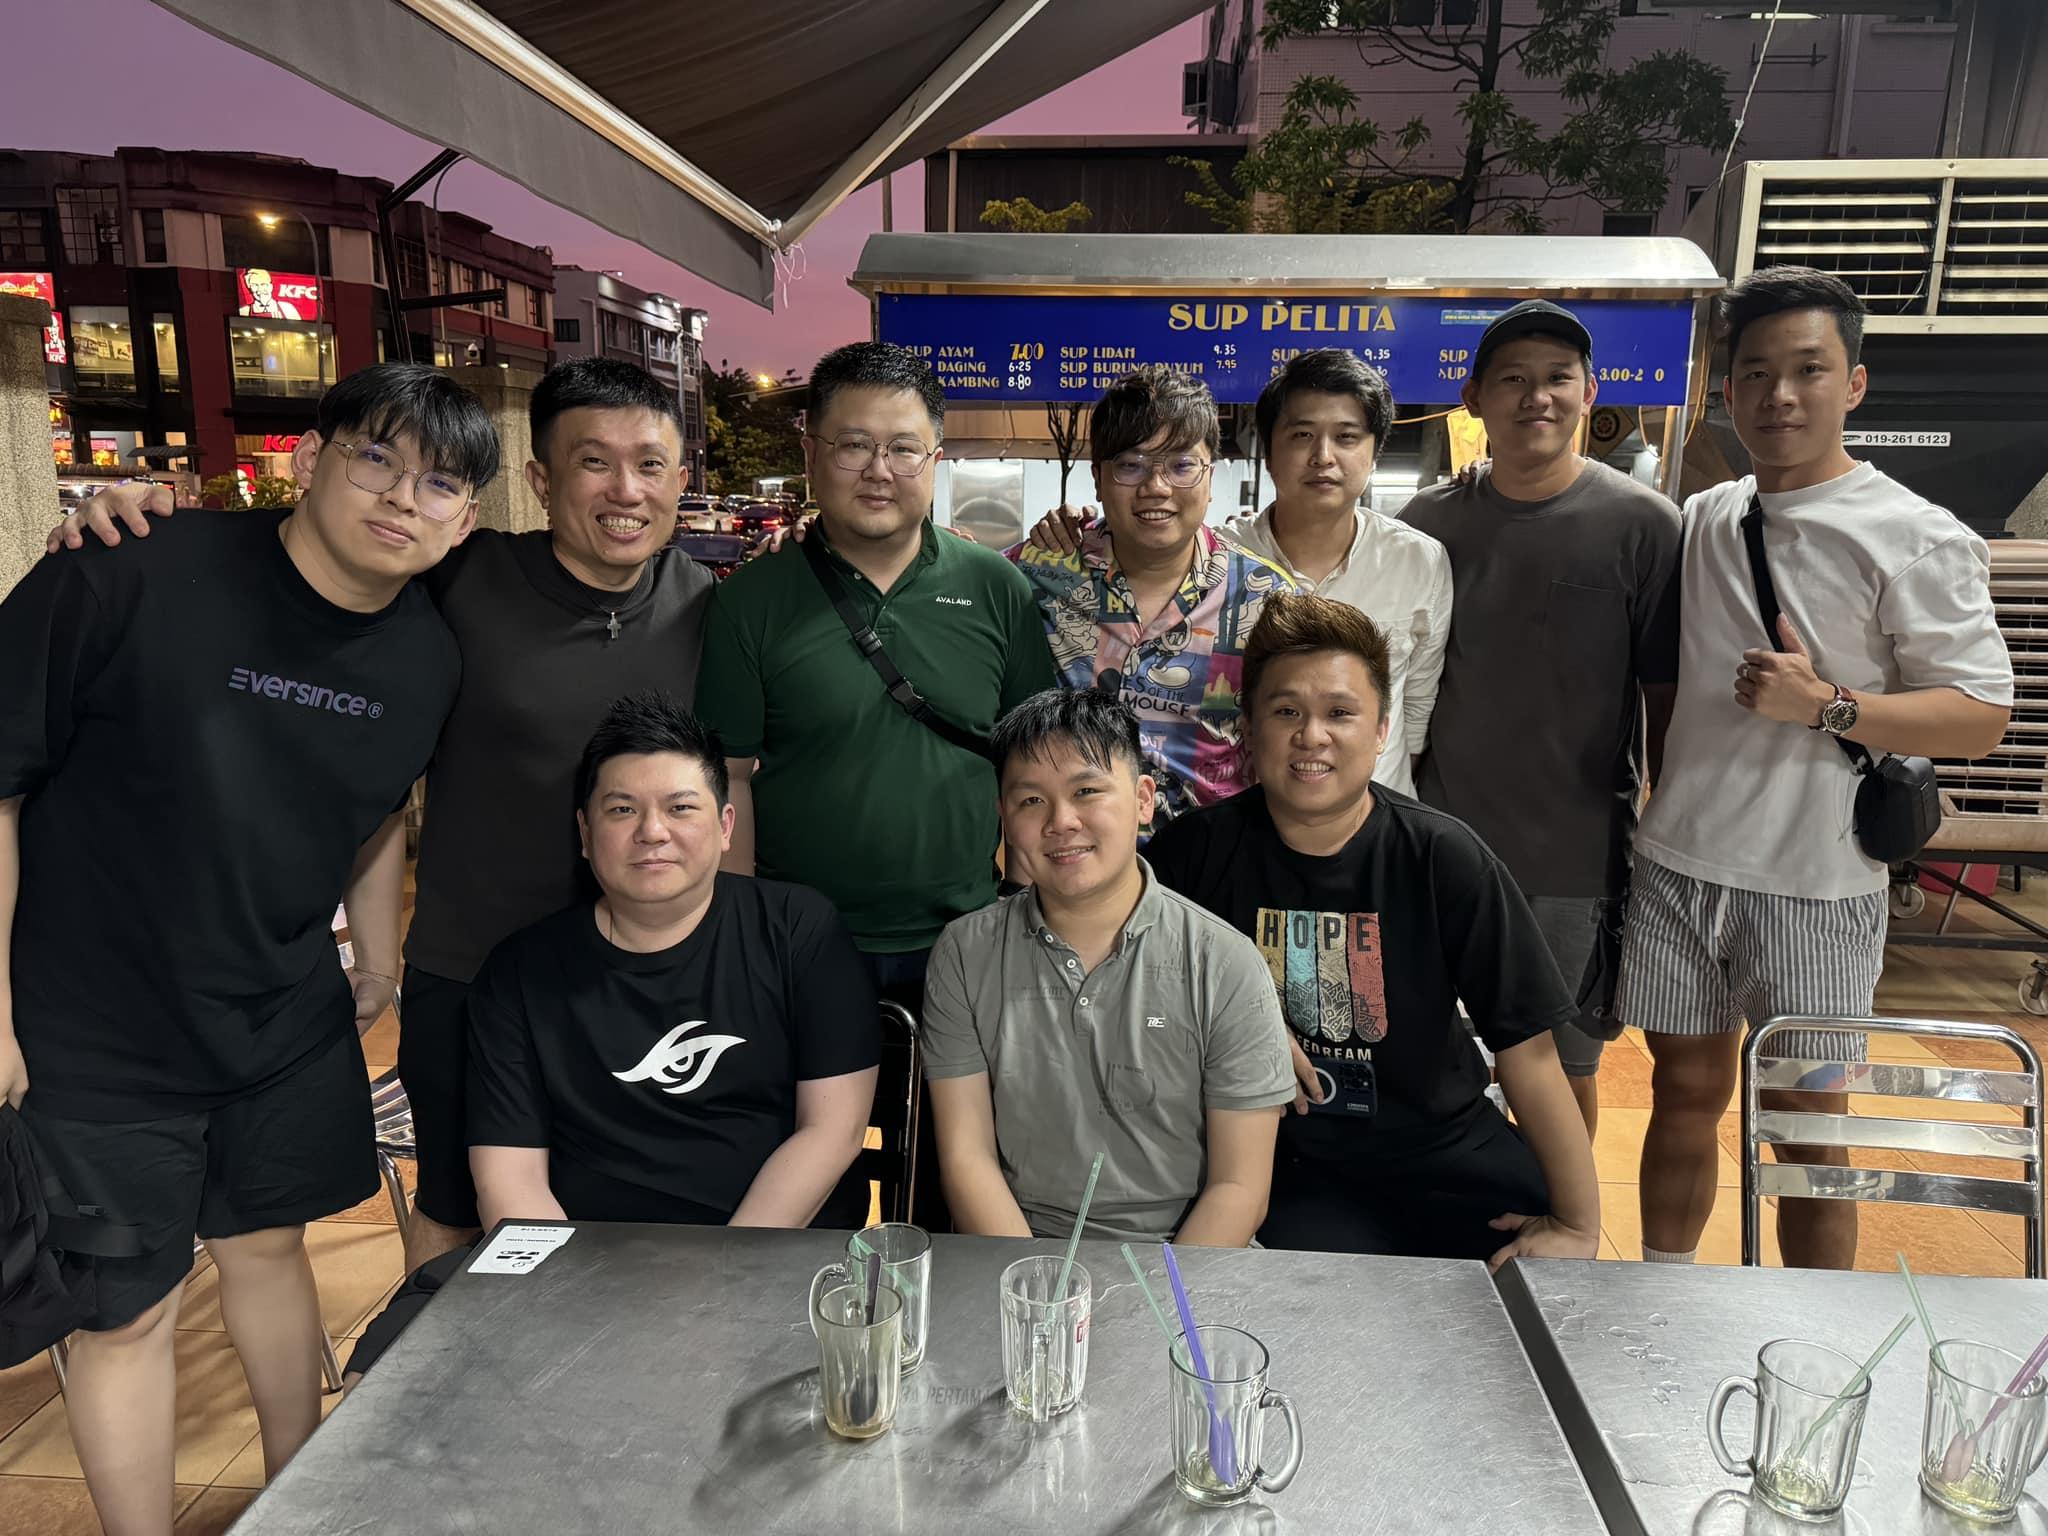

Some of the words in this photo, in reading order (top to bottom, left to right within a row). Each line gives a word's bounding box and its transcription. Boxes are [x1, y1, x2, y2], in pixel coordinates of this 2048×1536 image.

[278, 284, 318, 300] KFC
[1168, 303, 1248, 330] SUP
[1261, 304, 1396, 331] PELITA
[938, 346, 974, 358] AYAM
[1060, 346, 1088, 359] SUP
[1213, 344, 1237, 356] 9.35
[1364, 348, 1391, 360] 9.35
[1439, 349, 1468, 363] SUP
[938, 361, 986, 373] DAGING
[1060, 362, 1088, 374] SUP
[938, 376, 1000, 388] KAMBING
[1060, 377, 1087, 389] SUP
[263, 435, 300, 452] KF
[1865, 435, 1913, 444] 019-261
[1917, 435, 1948, 444] 6123
[935, 595, 972, 606] AVALAND
[1262, 912, 1372, 952] HOPE
